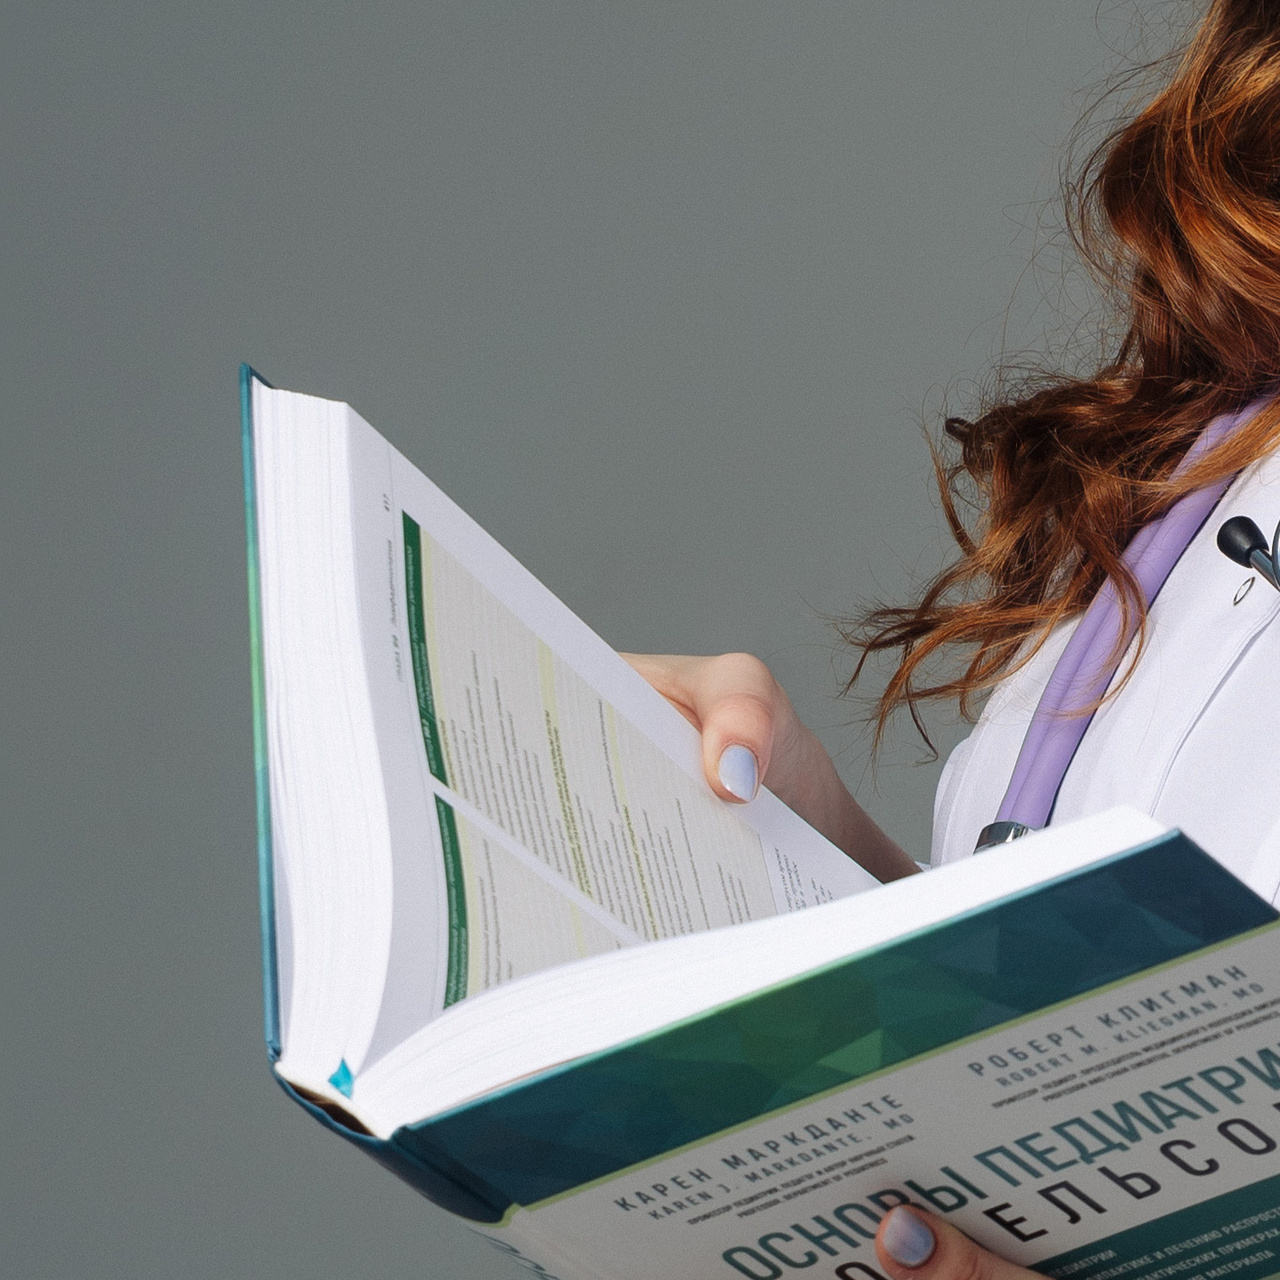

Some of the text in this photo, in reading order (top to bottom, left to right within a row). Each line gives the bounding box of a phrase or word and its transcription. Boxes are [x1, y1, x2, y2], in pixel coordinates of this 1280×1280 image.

[968, 1024, 1085, 1077] РОБЕРТ
[1097, 965, 1248, 1029] КЛИГМАН
[996, 1052, 1074, 1087] ROBERT
[613, 1168, 713, 1212] КАРЕН
[721, 1094, 904, 1171] МАРКДАНТЕ
[648, 1190, 713, 1220] KAREN
[882, 1113, 915, 1130] MD
[1153, 1251, 1166, 1260] И
[1163, 1229, 1223, 1256] ЛЕЧЕНИЮ
[1205, 1249, 1276, 1279] МАТЕРИАЛА
